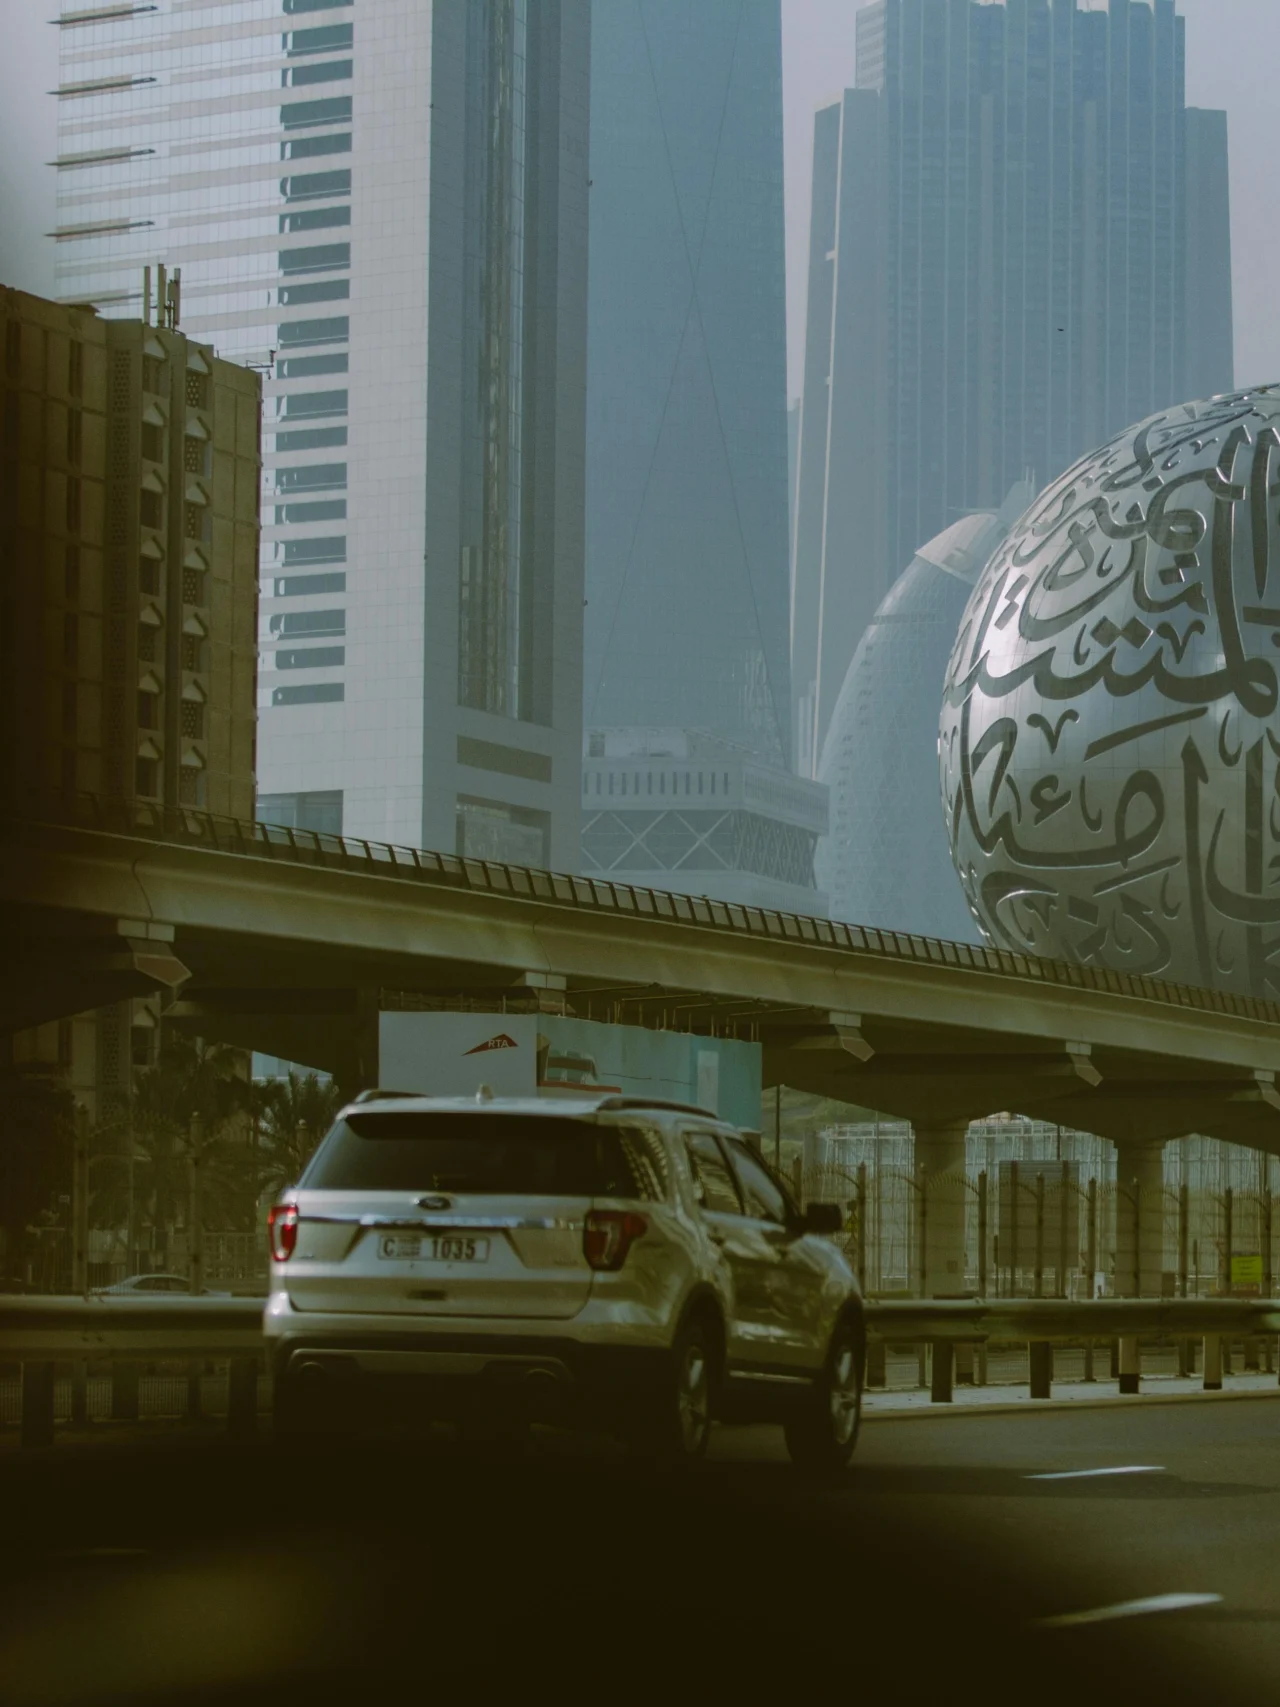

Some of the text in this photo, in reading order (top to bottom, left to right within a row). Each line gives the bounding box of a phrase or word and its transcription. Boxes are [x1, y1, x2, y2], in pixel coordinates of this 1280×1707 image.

[488, 1039, 510, 1048] RTA
[383, 1238, 395, 1257] C
[431, 1238, 477, 1260] 1035
